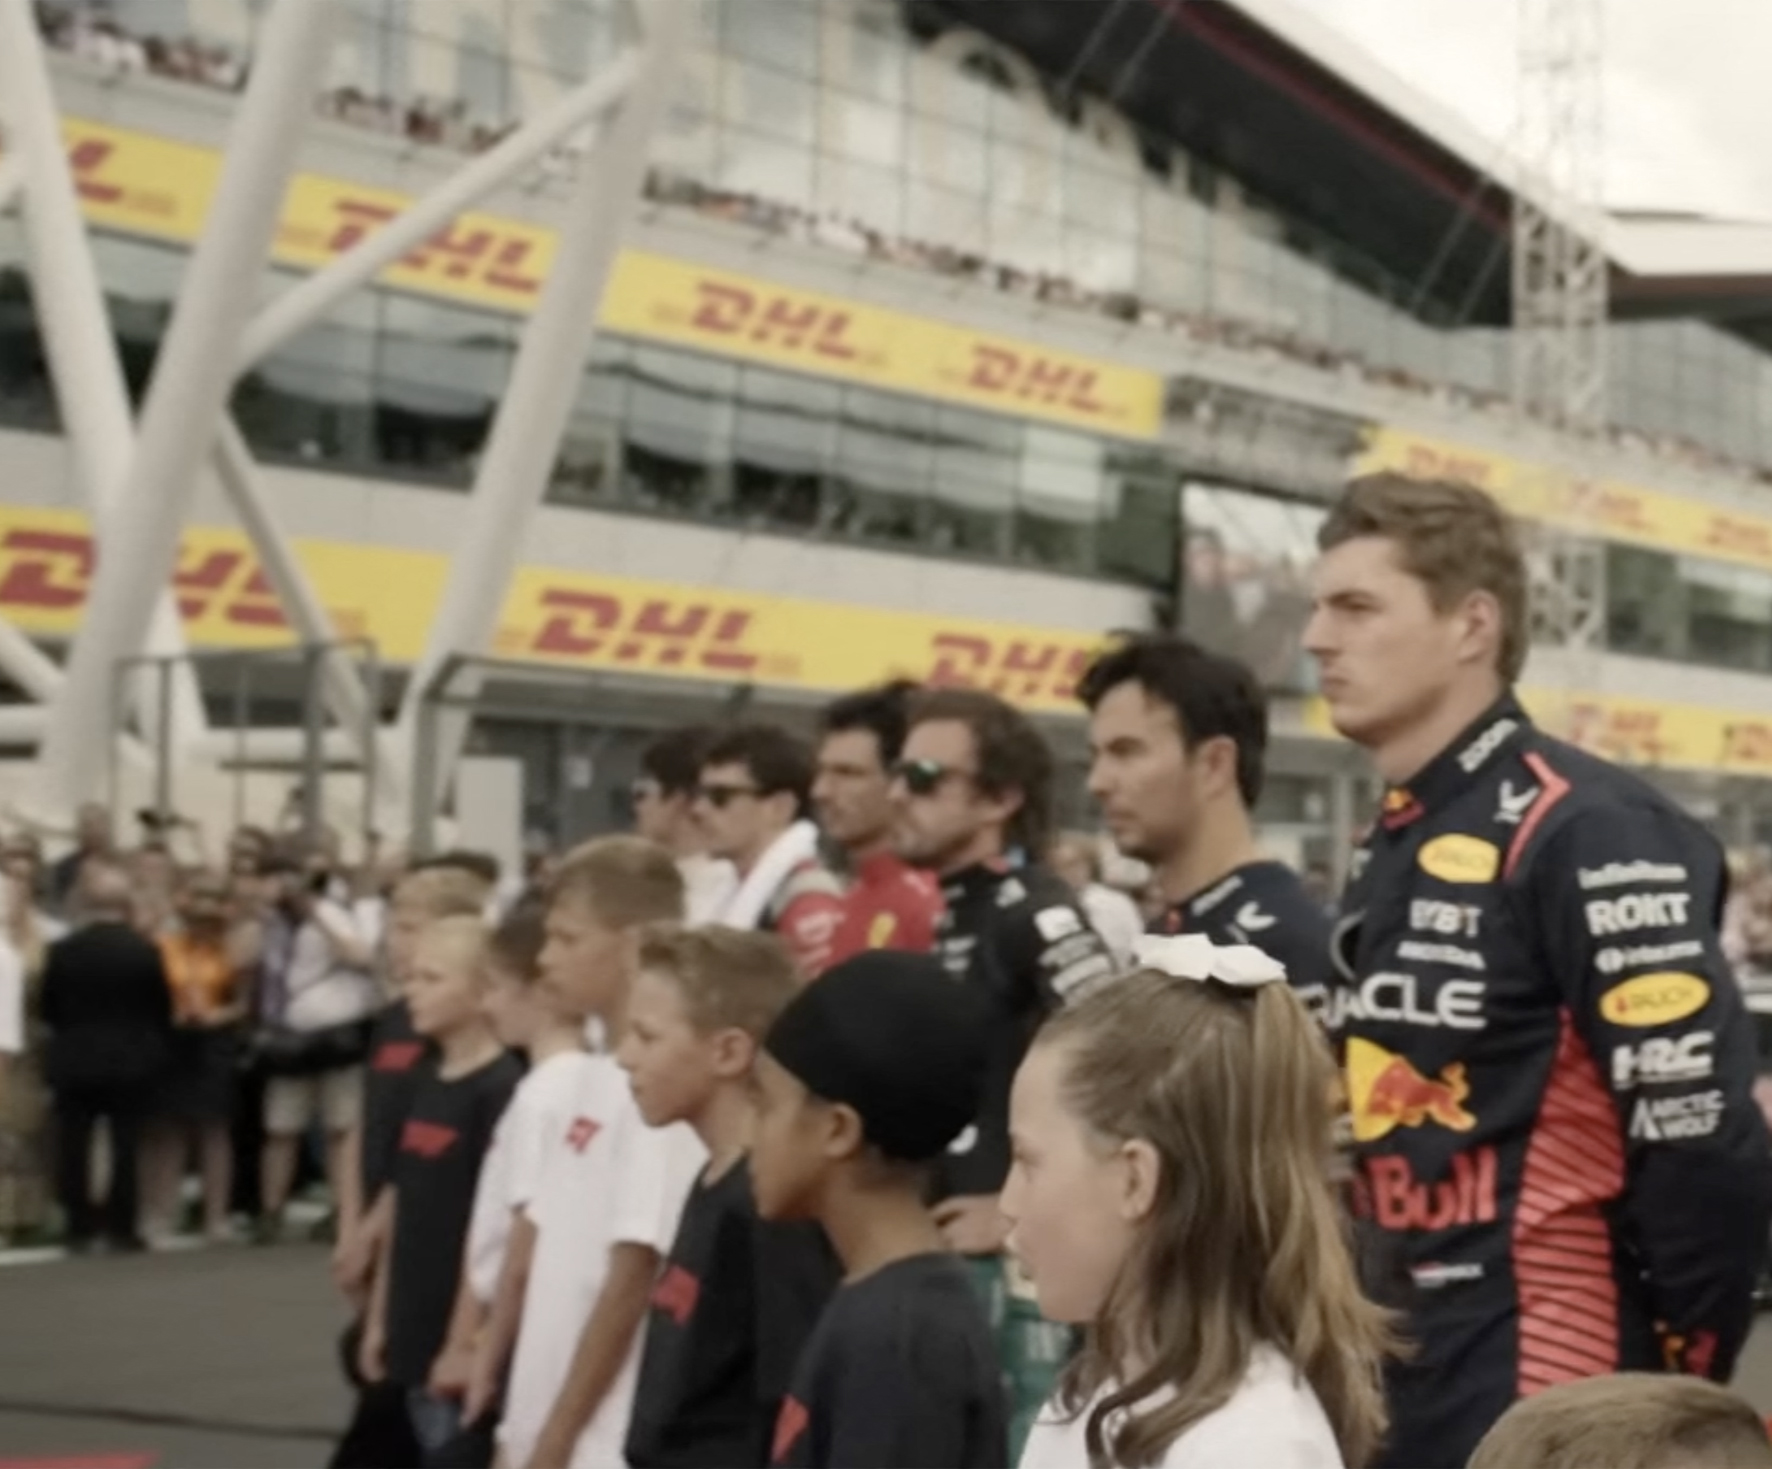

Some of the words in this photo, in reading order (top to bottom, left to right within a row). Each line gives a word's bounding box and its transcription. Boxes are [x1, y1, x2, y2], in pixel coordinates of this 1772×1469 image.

[690, 281, 856, 361] DHL
[966, 343, 1102, 413] DHL
[532, 588, 758, 670] DHL
[1585, 892, 1691, 937] ROKT
[1295, 970, 1487, 1029] RACLE
[1613, 1030, 1714, 1083] HRC
